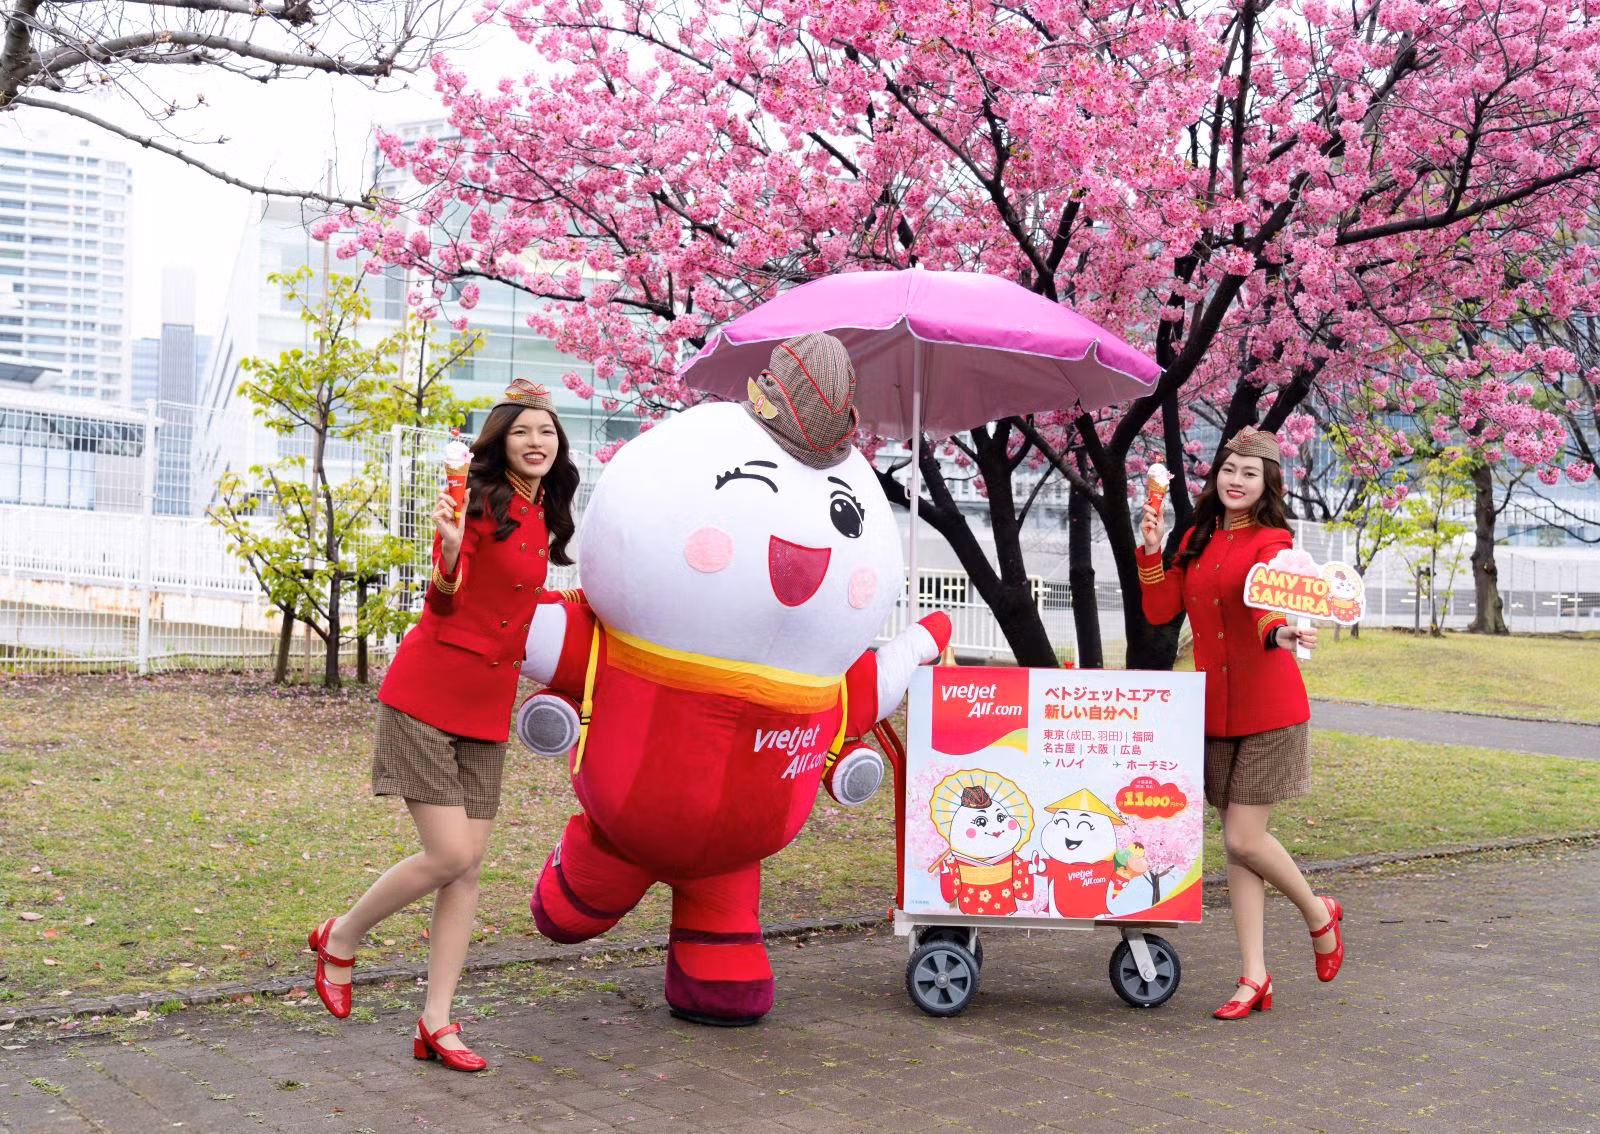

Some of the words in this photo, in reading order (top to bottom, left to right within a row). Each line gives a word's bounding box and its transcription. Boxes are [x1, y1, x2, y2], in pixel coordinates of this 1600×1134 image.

[1253, 567, 1299, 590] AMY
[1302, 577, 1328, 597] TO
[1250, 585, 1330, 617] SAKURA
[1044, 686, 1172, 703] ベトジェットエアで
[967, 702, 1023, 718] Air.com
[1044, 704, 1139, 721] 新しい自分へ!
[1043, 743, 1076, 754] 名古屋
[1087, 744, 1109, 755] 大阪
[1120, 745, 1142, 756] 広島
[1055, 758, 1085, 769] ハノイ
[1126, 760, 1179, 771] ホーチミン
